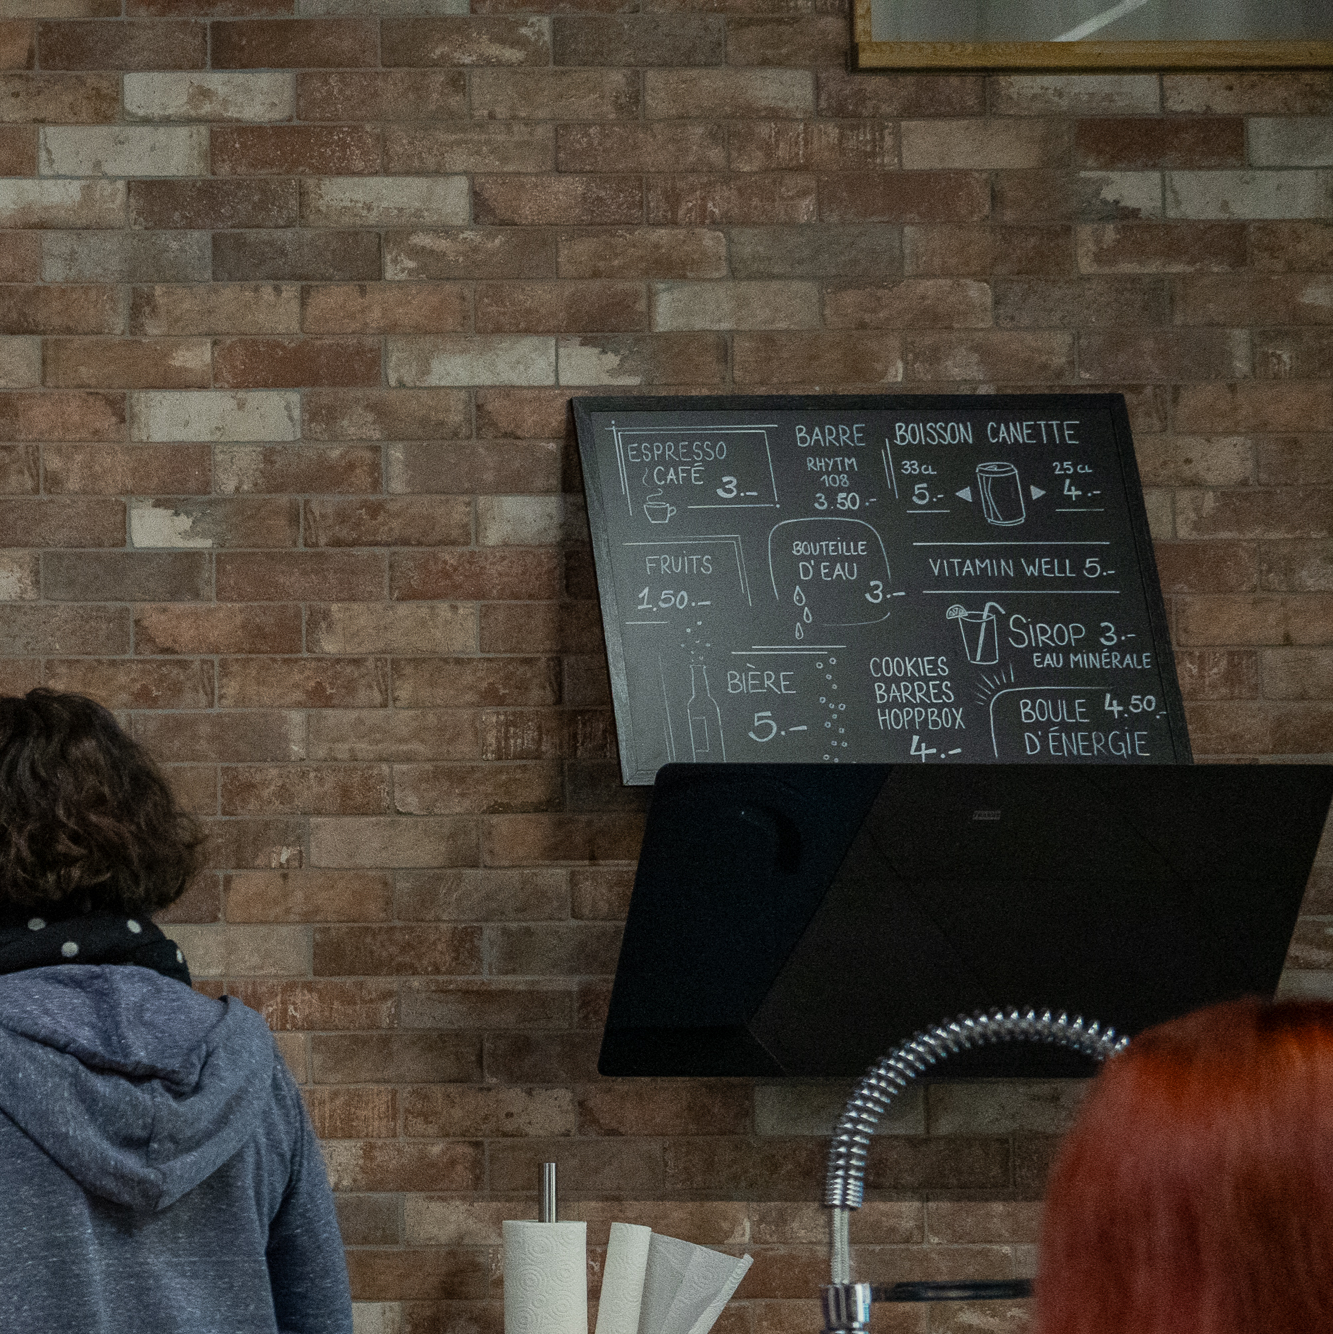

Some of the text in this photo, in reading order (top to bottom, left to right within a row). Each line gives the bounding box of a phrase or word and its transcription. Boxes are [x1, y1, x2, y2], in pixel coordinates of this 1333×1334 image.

[795, 424, 866, 447] BARRE
[894, 421, 1080, 446] BOISSON CANETTE
[628, 441, 728, 462] ESPRESSO
[654, 463, 706, 485] CAFÉ
[806, 456, 859, 472] RHYTM
[820, 474, 850, 487] 108
[792, 538, 868, 556] BOUTEILLE
[645, 551, 713, 575] FRUITS
[798, 560, 858, 580] D'EAU
[929, 558, 1014, 577] VITAMIN
[1020, 558, 1076, 577] WELL
[1008, 614, 1085, 648] SIROP
[869, 656, 949, 678] COOKIES
[1033, 649, 1152, 669] EAU MINÉRALE
[727, 663, 797, 694] BIÈRE
[874, 681, 955, 704] BARRES
[877, 707, 966, 730] HOPPBOX
[1019, 699, 1090, 723] BOULE
[1024, 726, 1151, 759] D'ÉNERGIE
